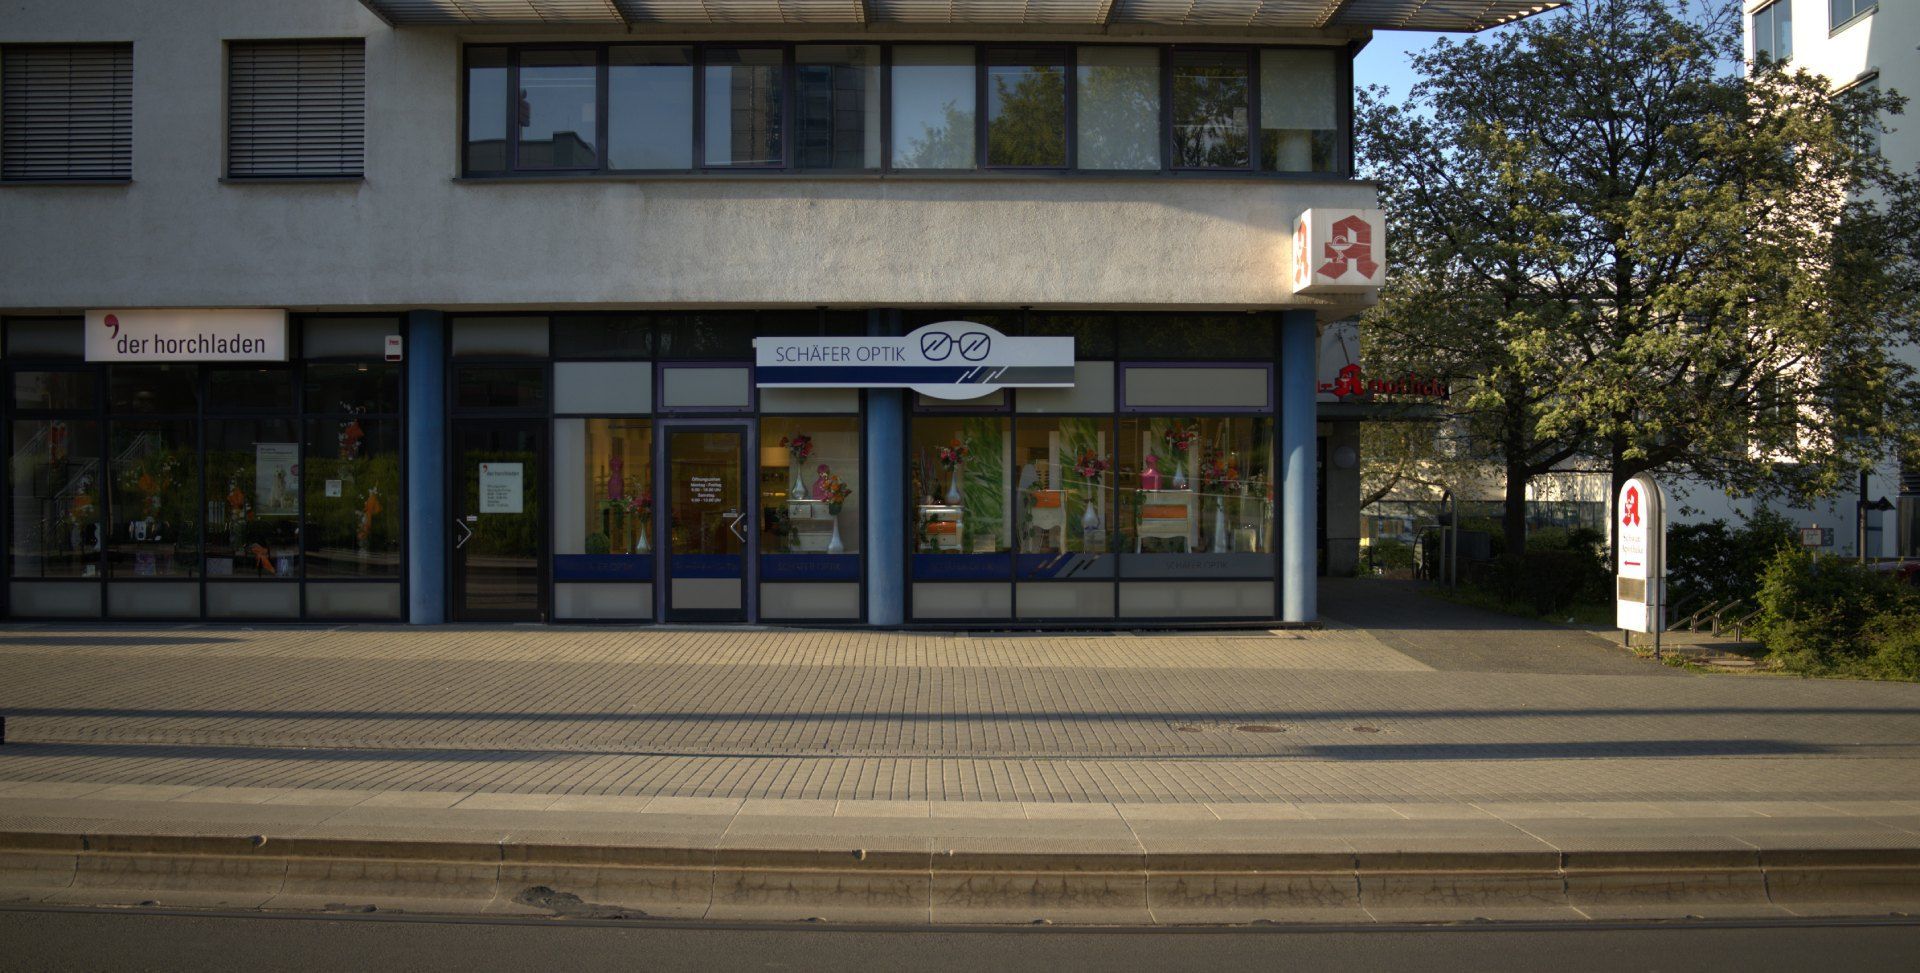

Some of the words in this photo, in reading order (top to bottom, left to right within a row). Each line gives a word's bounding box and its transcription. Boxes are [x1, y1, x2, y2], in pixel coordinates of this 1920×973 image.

[117, 333, 150, 354] der
[154, 333, 266, 354] horchladen
[776, 343, 852, 362] SCHÄFER
[856, 345, 906, 362] OPTIK
